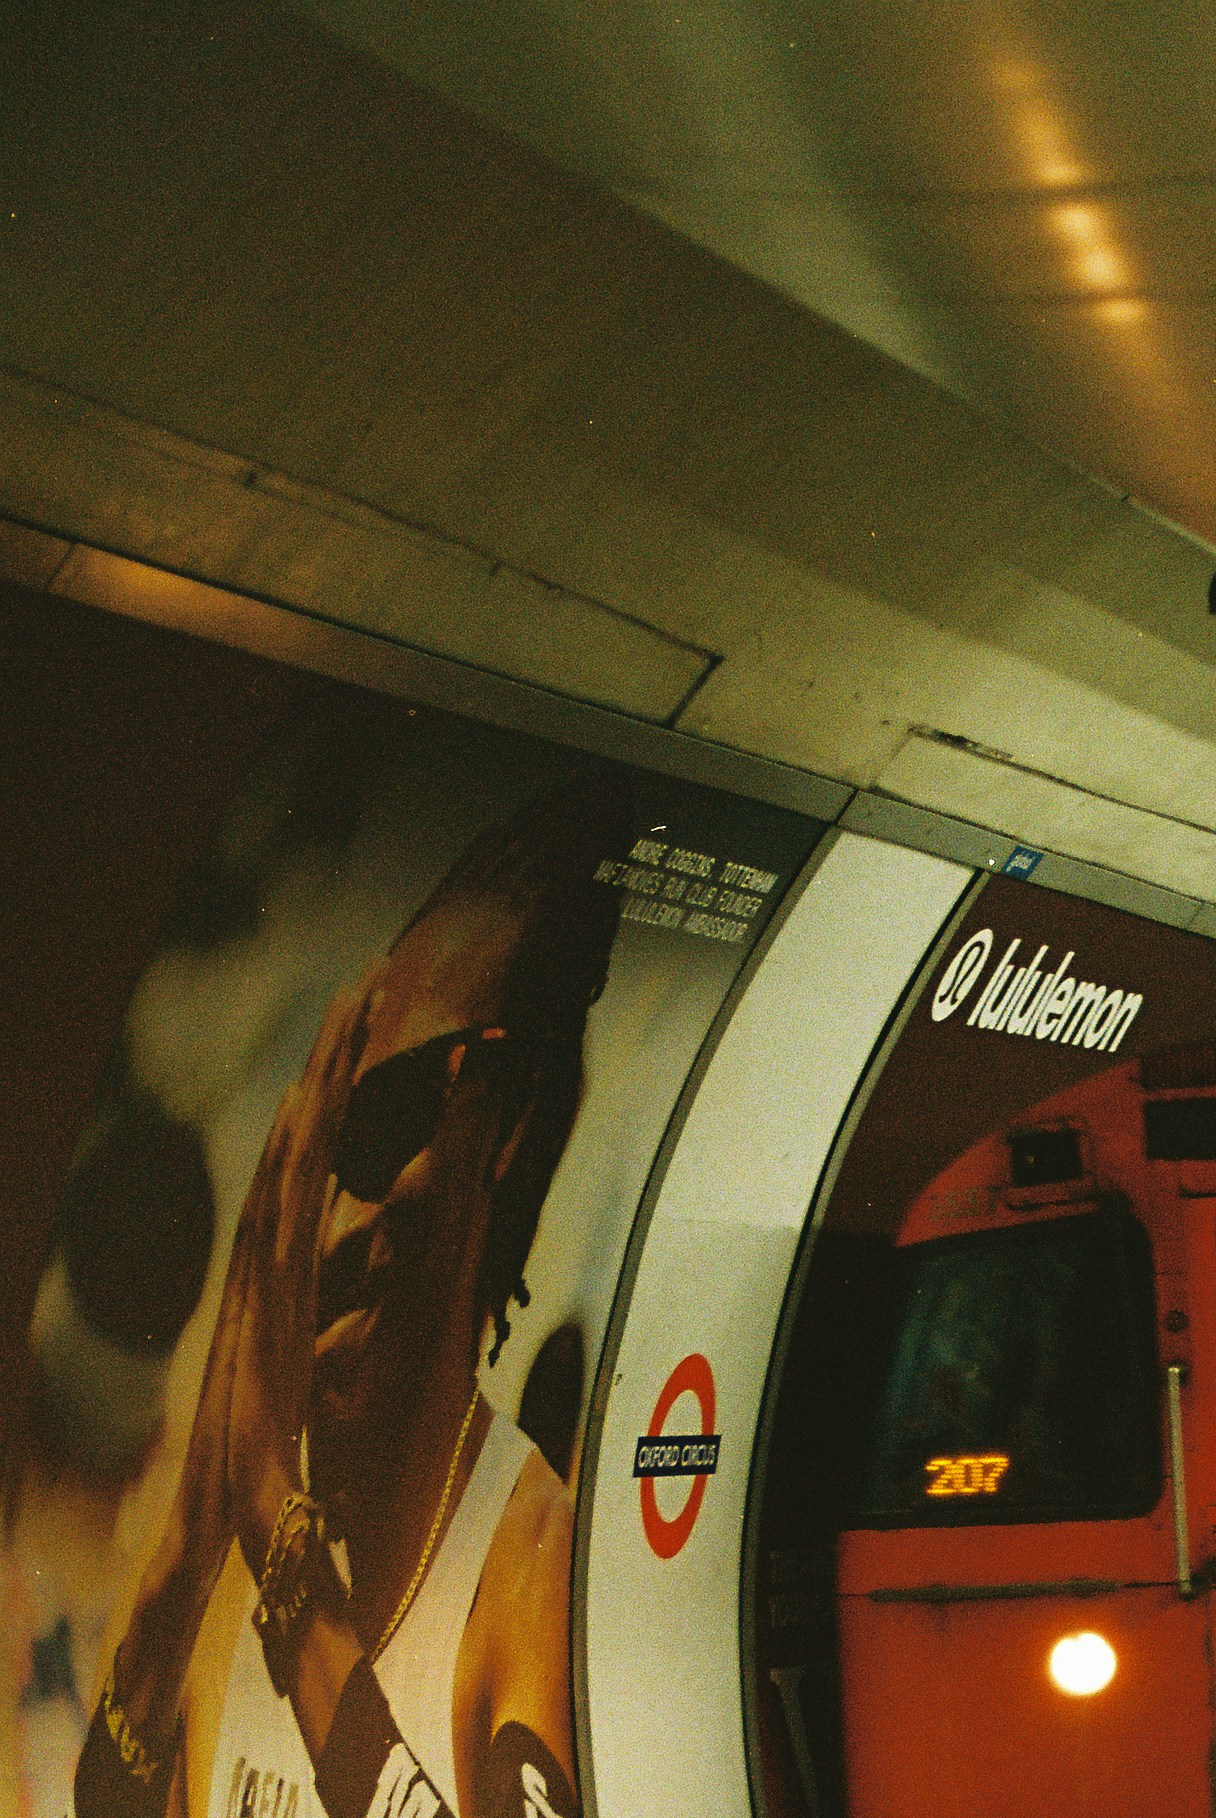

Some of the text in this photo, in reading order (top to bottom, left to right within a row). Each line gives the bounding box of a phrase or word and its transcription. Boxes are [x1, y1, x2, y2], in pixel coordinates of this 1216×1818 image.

[719, 861, 780, 895] TOTTENHAM
[684, 882, 718, 908] CLUB
[717, 889, 763, 918] FOUNDER
[965, 937, 1145, 1053] lululemon
[638, 1443, 717, 1469] OXFORD CIRCUS
[924, 1455, 1010, 1496] 207
